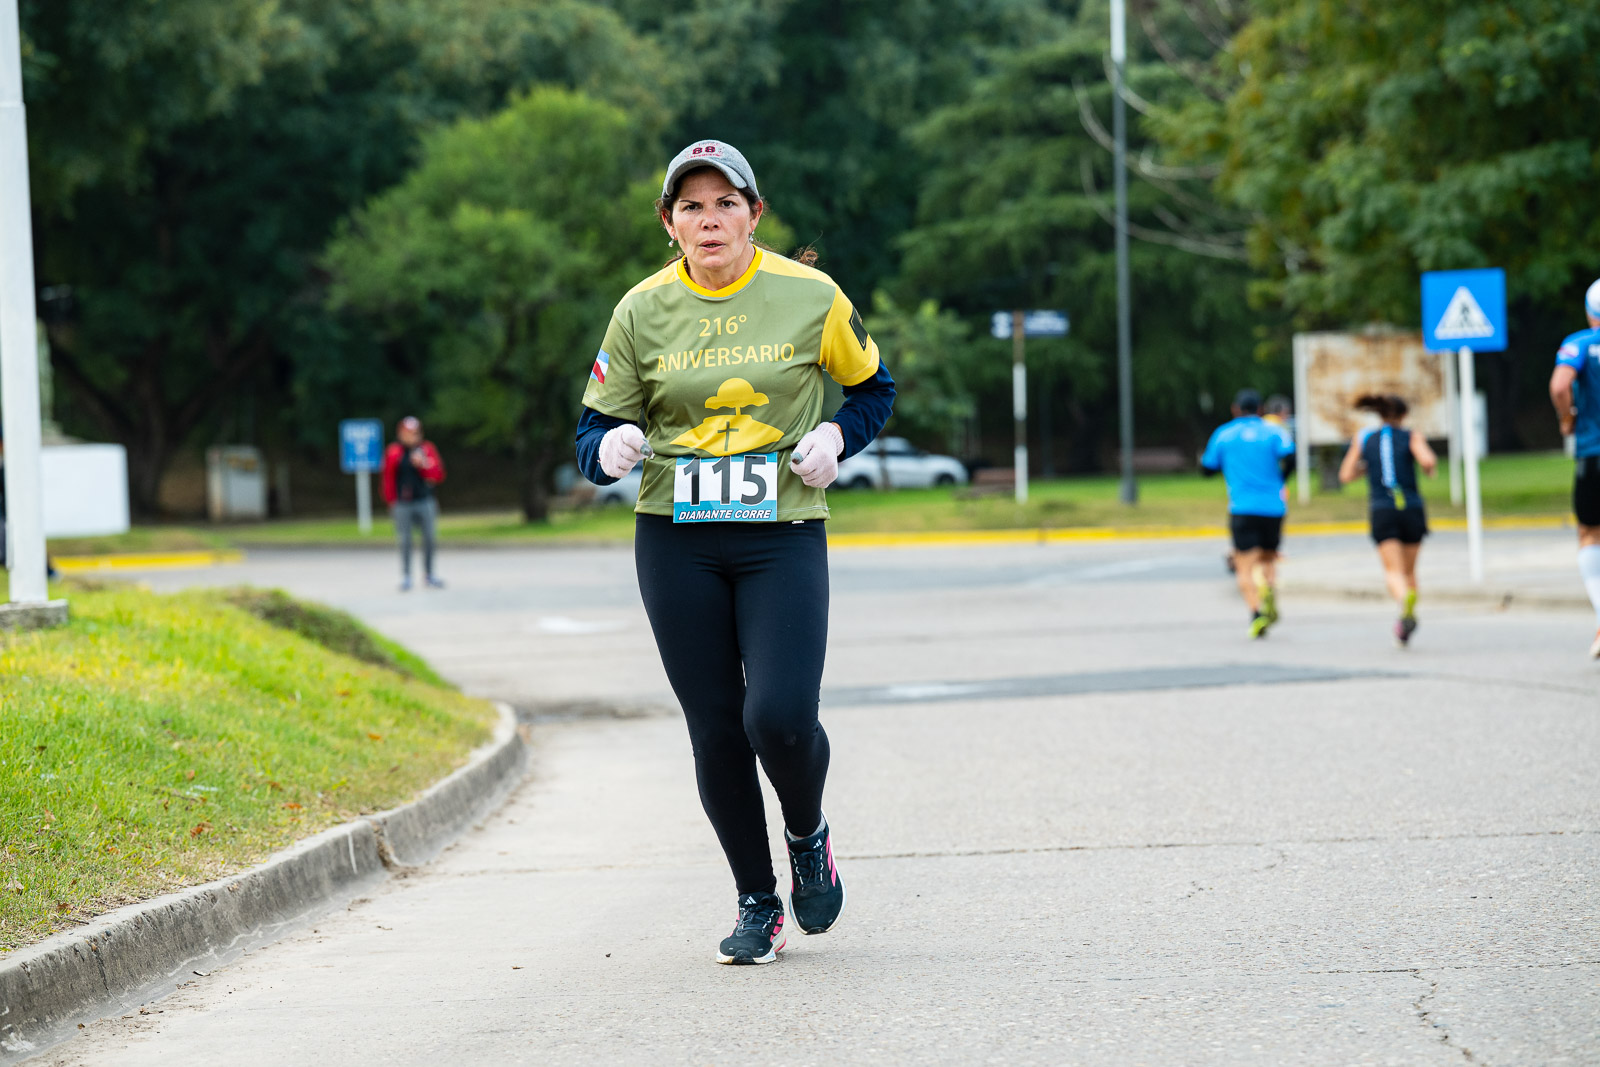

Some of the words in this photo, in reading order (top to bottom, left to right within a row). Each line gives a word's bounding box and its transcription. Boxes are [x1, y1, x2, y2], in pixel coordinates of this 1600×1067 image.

[692, 146, 716, 154] 88
[656, 343, 795, 373] ANIVERSARIO
[683, 455, 768, 506] 115
[678, 509, 733, 521] DIAMANTE
[734, 509, 772, 519] CORRE
